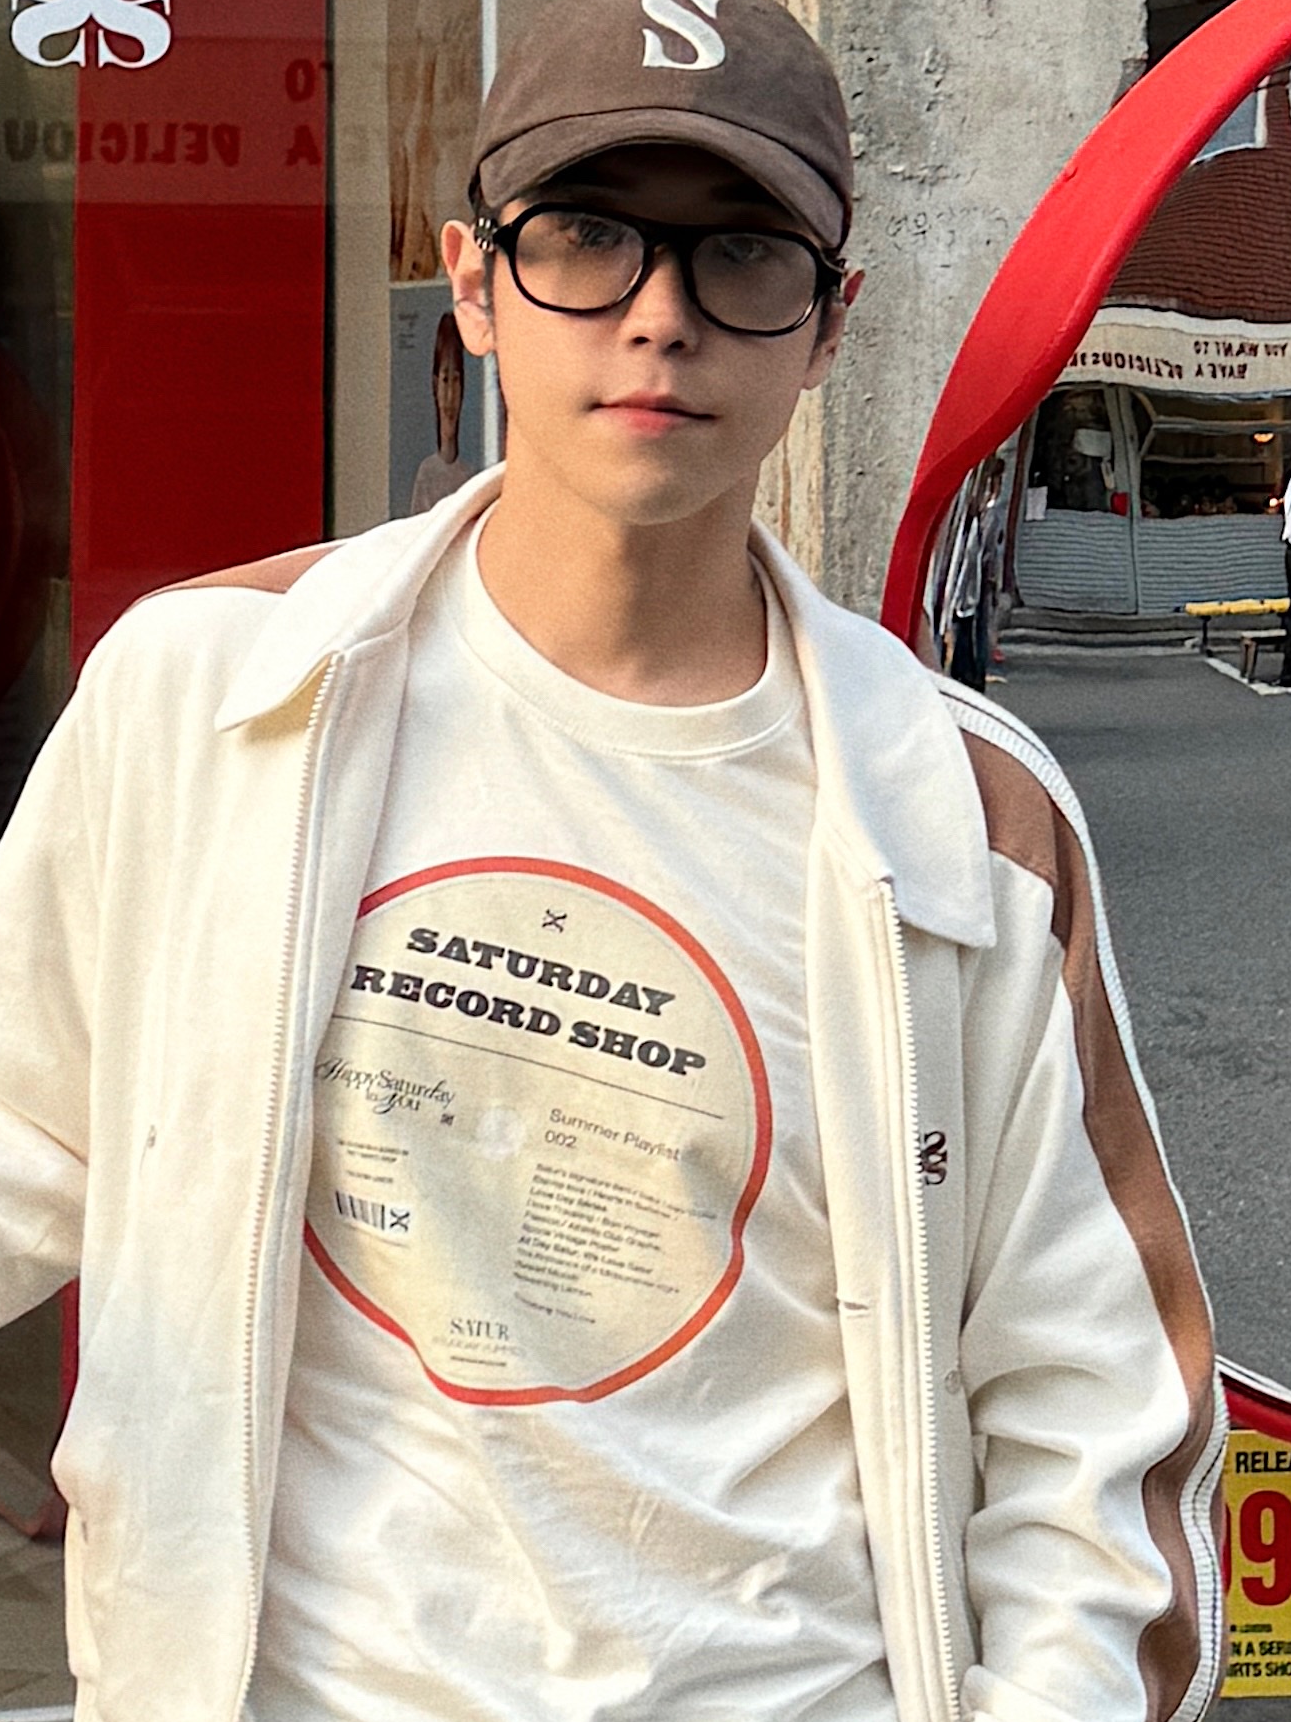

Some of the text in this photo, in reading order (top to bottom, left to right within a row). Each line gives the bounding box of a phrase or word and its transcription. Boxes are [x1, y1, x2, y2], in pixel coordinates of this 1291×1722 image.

[406, 927, 676, 1017] SATURDAY
[350, 964, 708, 1077] RECORD SHOP
[545, 1129, 578, 1150] 002
[549, 1108, 619, 1143] Summer
[450, 1318, 509, 1341] SATUR
